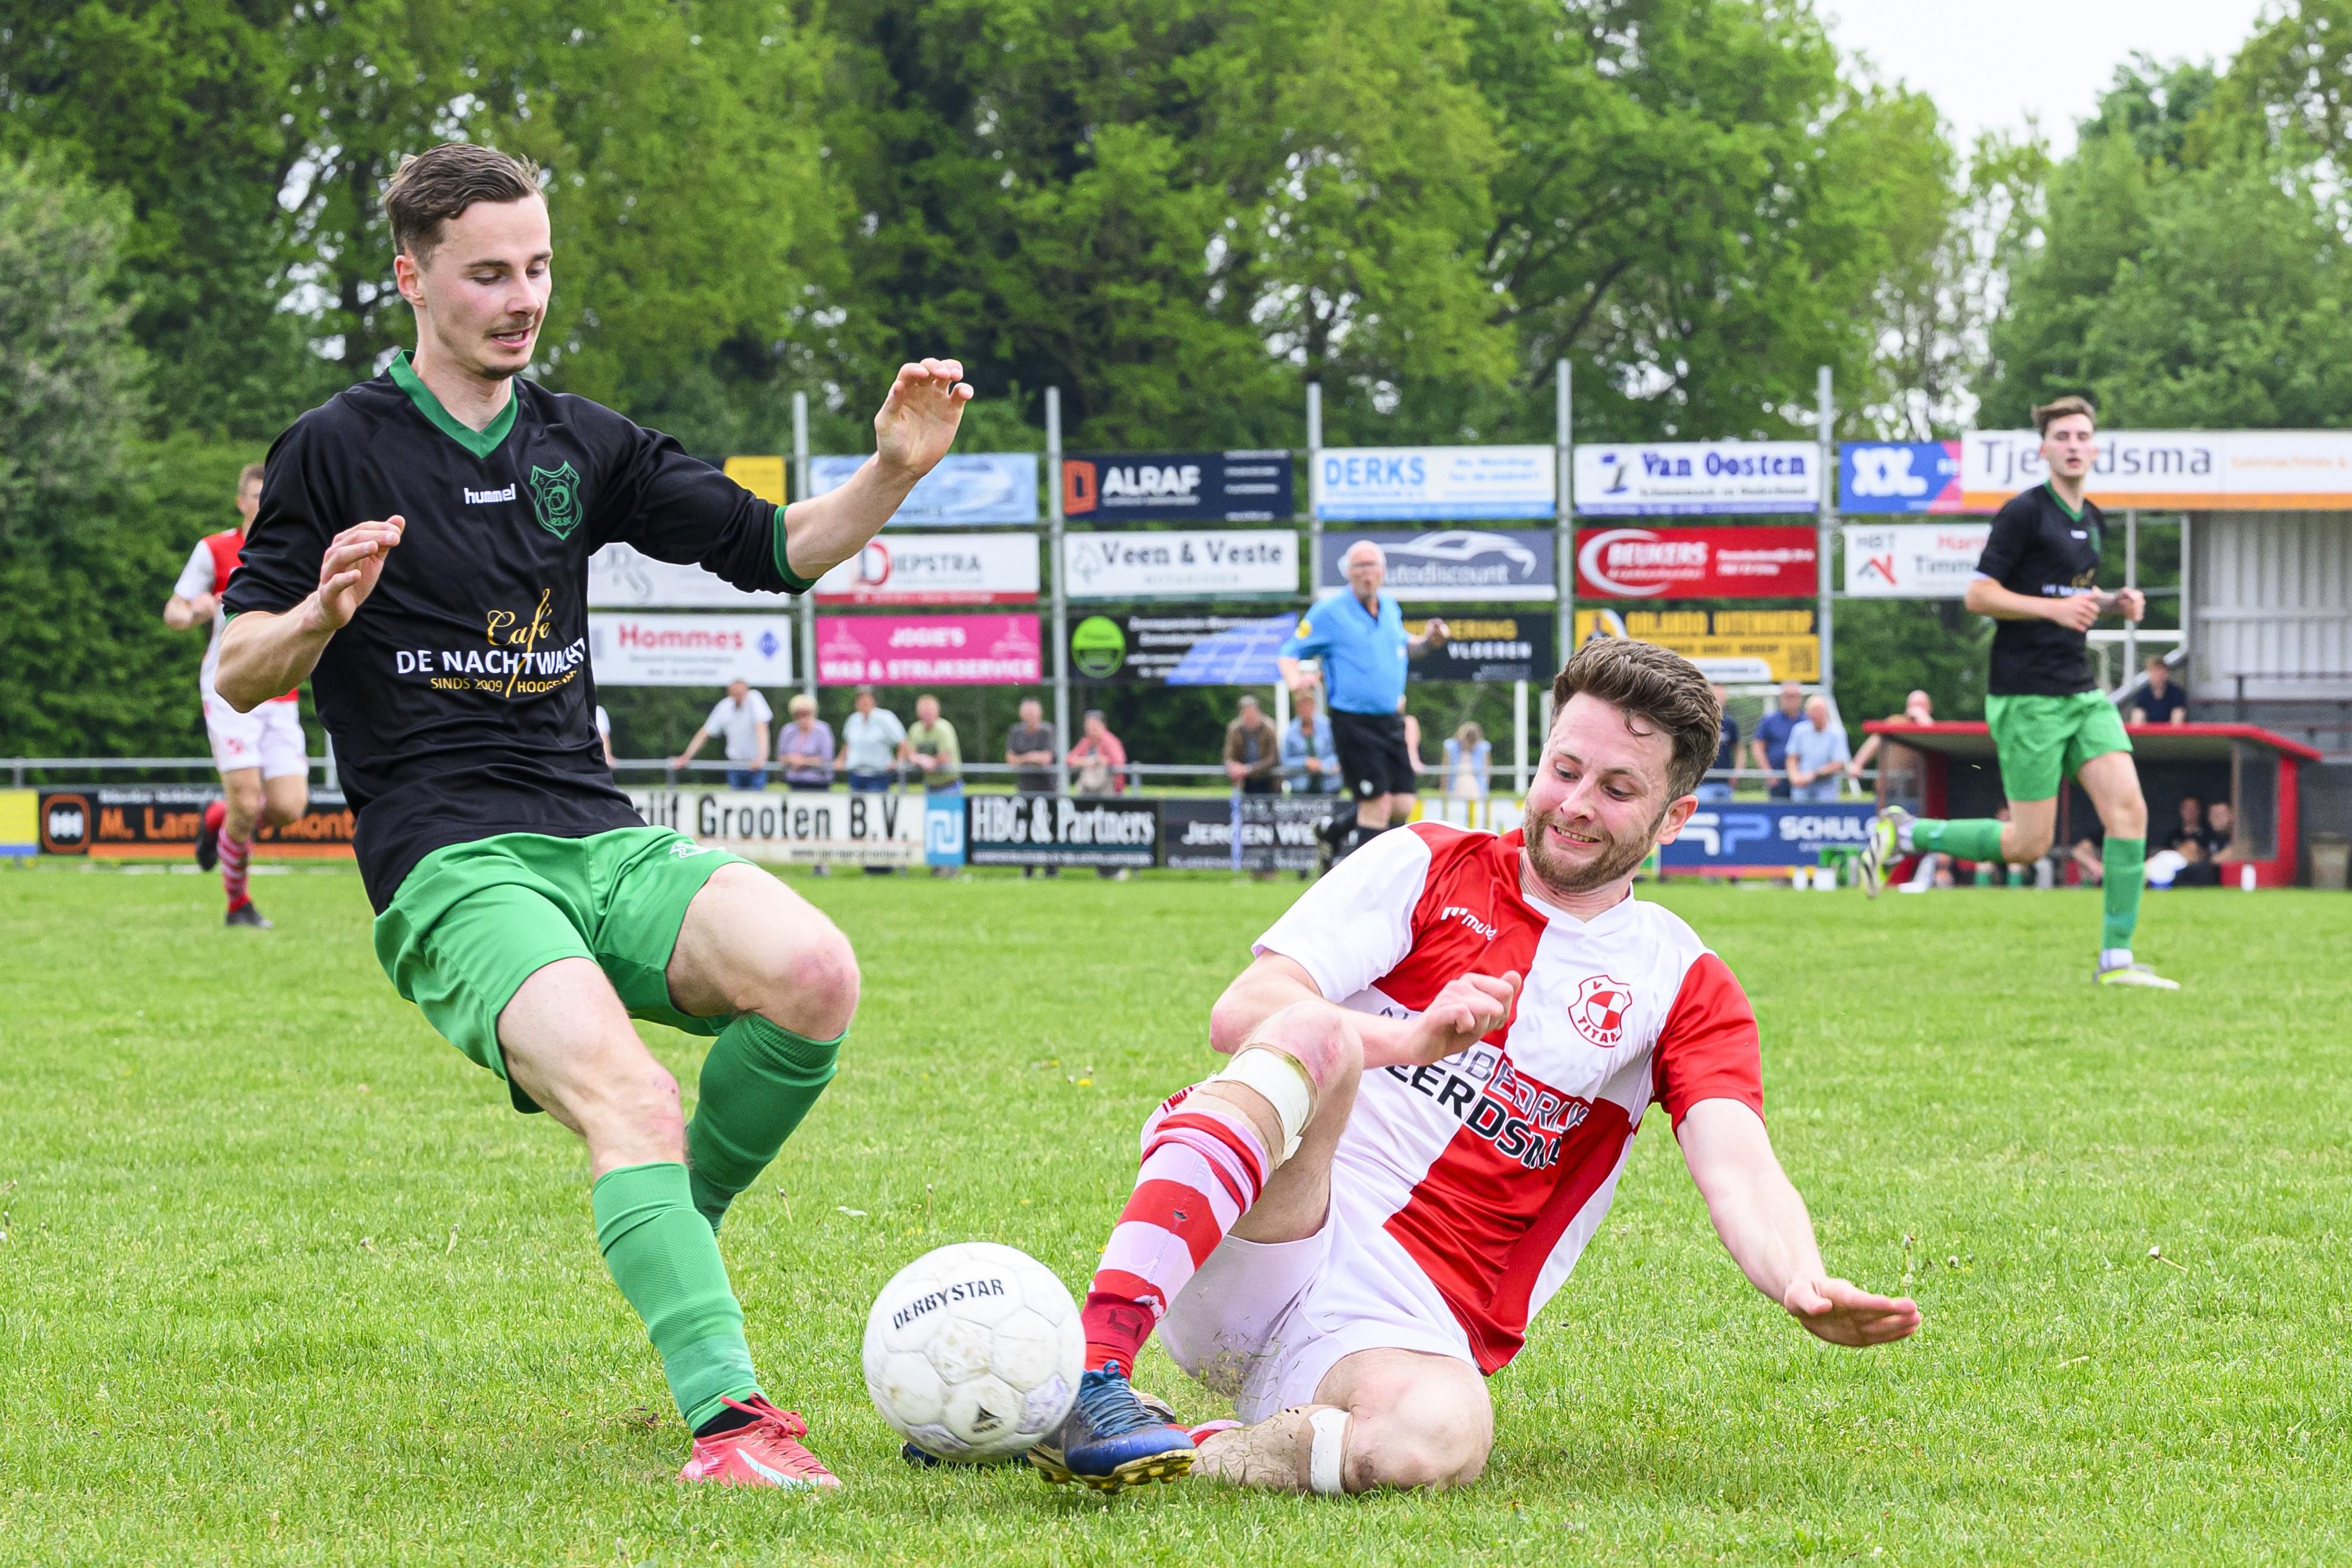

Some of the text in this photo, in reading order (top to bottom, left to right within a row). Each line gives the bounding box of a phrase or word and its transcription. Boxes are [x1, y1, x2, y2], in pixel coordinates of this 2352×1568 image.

[1324, 456, 1426, 485] DERKS
[1642, 452, 1806, 476] Van Oosten
[1851, 447, 1928, 496] XXL
[1978, 439, 2212, 484] Tjedsma
[464, 484, 516, 504] hummel
[1101, 464, 1201, 496] ALRAF
[1101, 538, 1283, 565] Veen & Veste
[1382, 562, 1508, 586] utodiscount
[618, 622, 744, 650] Hommes
[1447, 641, 1532, 660] VLOEREN
[397, 637, 586, 675] DE NACHTWACHT
[430, 678, 470, 690] SINDS
[475, 679, 503, 692] 2009
[99, 808, 135, 839] M.
[699, 793, 831, 840] Grooten
[849, 794, 909, 841] B.V.
[1029, 795, 1054, 844] &
[1057, 796, 1156, 846] Partners
[892, 1278, 1005, 1330] DERBYSTAR
